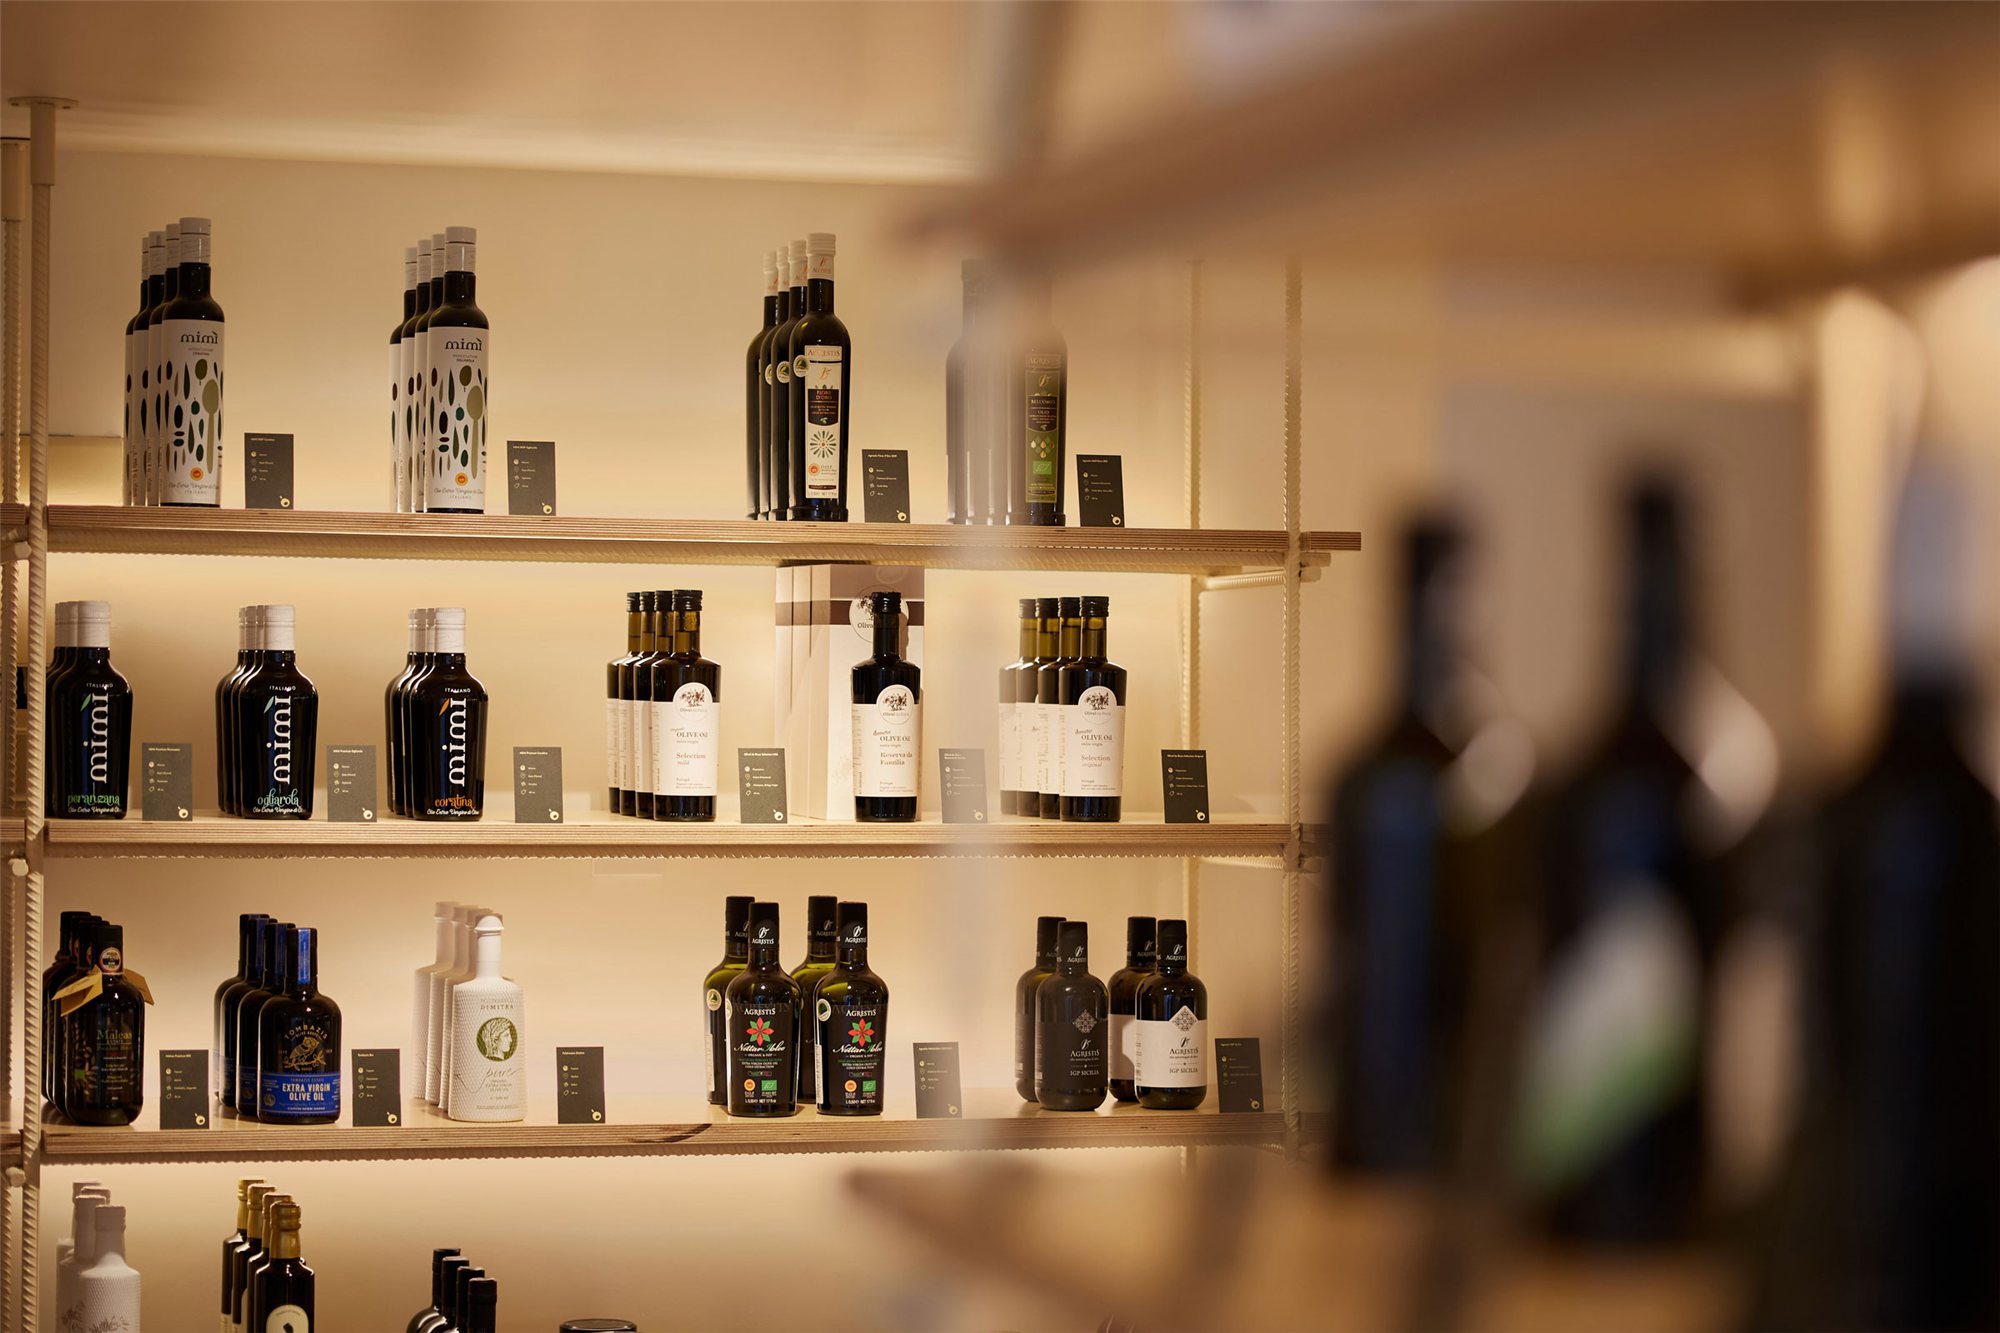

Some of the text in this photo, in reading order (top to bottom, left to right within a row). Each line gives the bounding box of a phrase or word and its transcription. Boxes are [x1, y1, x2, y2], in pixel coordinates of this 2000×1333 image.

[744, 1007, 776, 1016] AGRESTIS
[845, 1009, 877, 1017] AGRESTIS
[284, 1024, 328, 1040] TOMBAZIS
[282, 1083, 305, 1092] EXTRA
[308, 1083, 331, 1091] VIRGIN
[289, 1092, 324, 1101] OLIVE OIL
